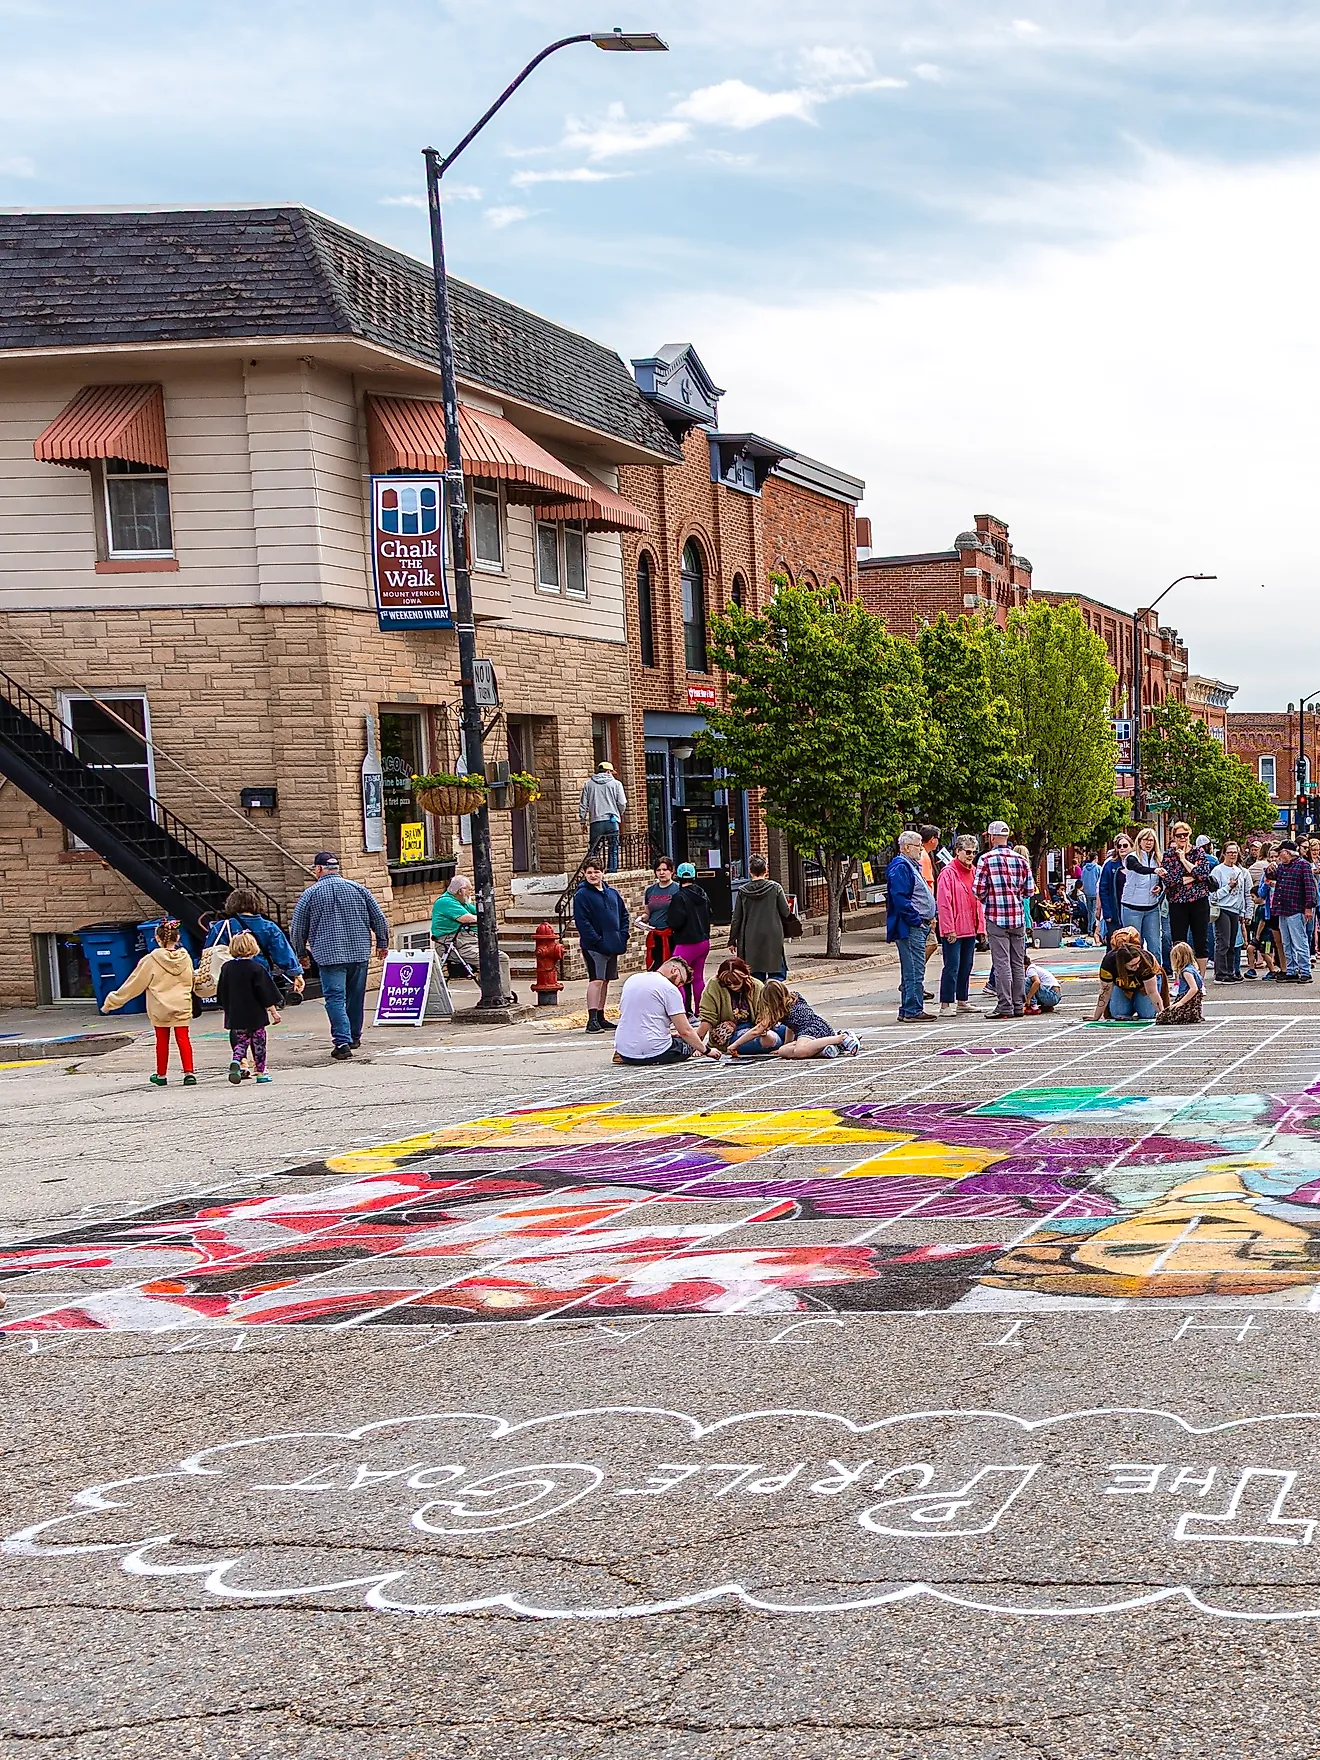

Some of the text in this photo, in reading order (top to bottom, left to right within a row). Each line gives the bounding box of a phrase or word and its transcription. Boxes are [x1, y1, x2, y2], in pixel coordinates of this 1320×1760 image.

[380, 540, 438, 558] Chalk
[399, 559, 423, 569] THE
[384, 569, 435, 587] Walk
[389, 611, 423, 620] WEEKEND
[424, 610, 433, 619] IN
[433, 609, 449, 619] MAY
[382, 755, 414, 778] NCOLN
[201, 996, 217, 1004] TRAS
[387, 986, 421, 996] HAPPY
[389, 997, 415, 1006] DAZE
[738, 1317, 849, 1346] J
[1171, 1314, 1263, 1342] H
[252, 1462, 605, 1536] GOAT
[616, 1459, 1043, 1539] PURPLE
[1103, 1462, 1320, 1546] THE
